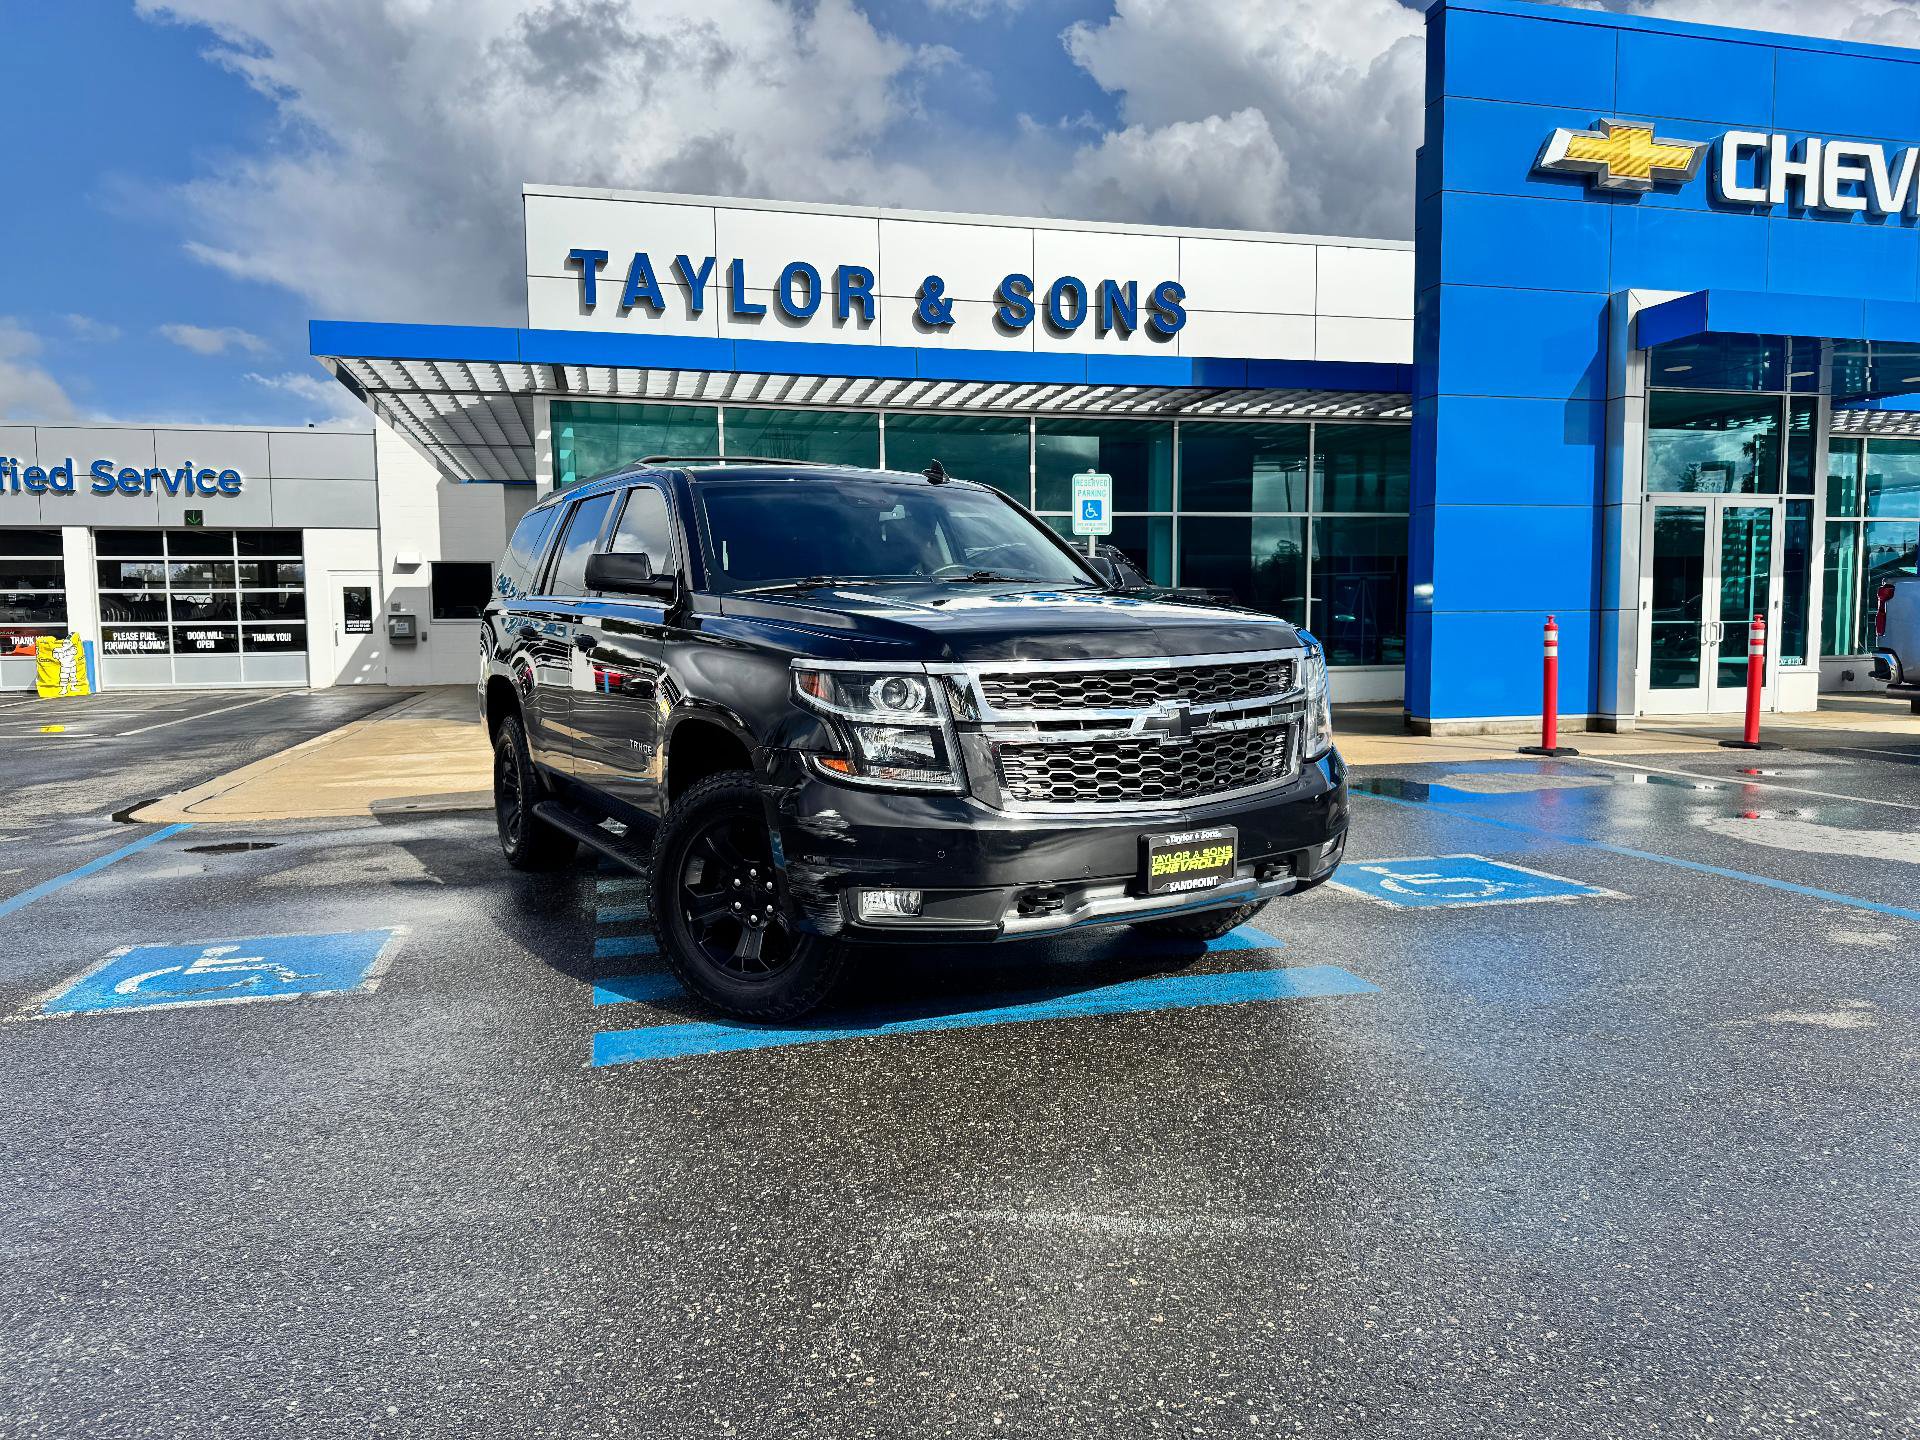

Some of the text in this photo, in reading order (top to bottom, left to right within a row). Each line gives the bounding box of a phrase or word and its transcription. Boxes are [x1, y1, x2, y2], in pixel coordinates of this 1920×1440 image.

[1721, 130, 1920, 215] CHEV
[569, 248, 1187, 334] TAYLOR & SONS
[0, 456, 242, 494] fied Service
[1075, 479, 1108, 487] RESERVED
[1077, 489, 1107, 497] PARKING
[112, 631, 158, 641] PLEASE PULL
[187, 630, 224, 640] DOOR WILL
[252, 632, 292, 642] THANK YOU!
[10, 635, 35, 647] THANK
[104, 640, 166, 650] FORWARD SLOWLY
[196, 640, 215, 649] OPEN
[629, 739, 653, 755] TAHOE
[1169, 833, 1193, 844] Taylor
[1151, 845, 1233, 865] TAYLOR & SONS
[1151, 853, 1234, 877] CHEVROLET
[1169, 875, 1219, 893] SANDPOINT
